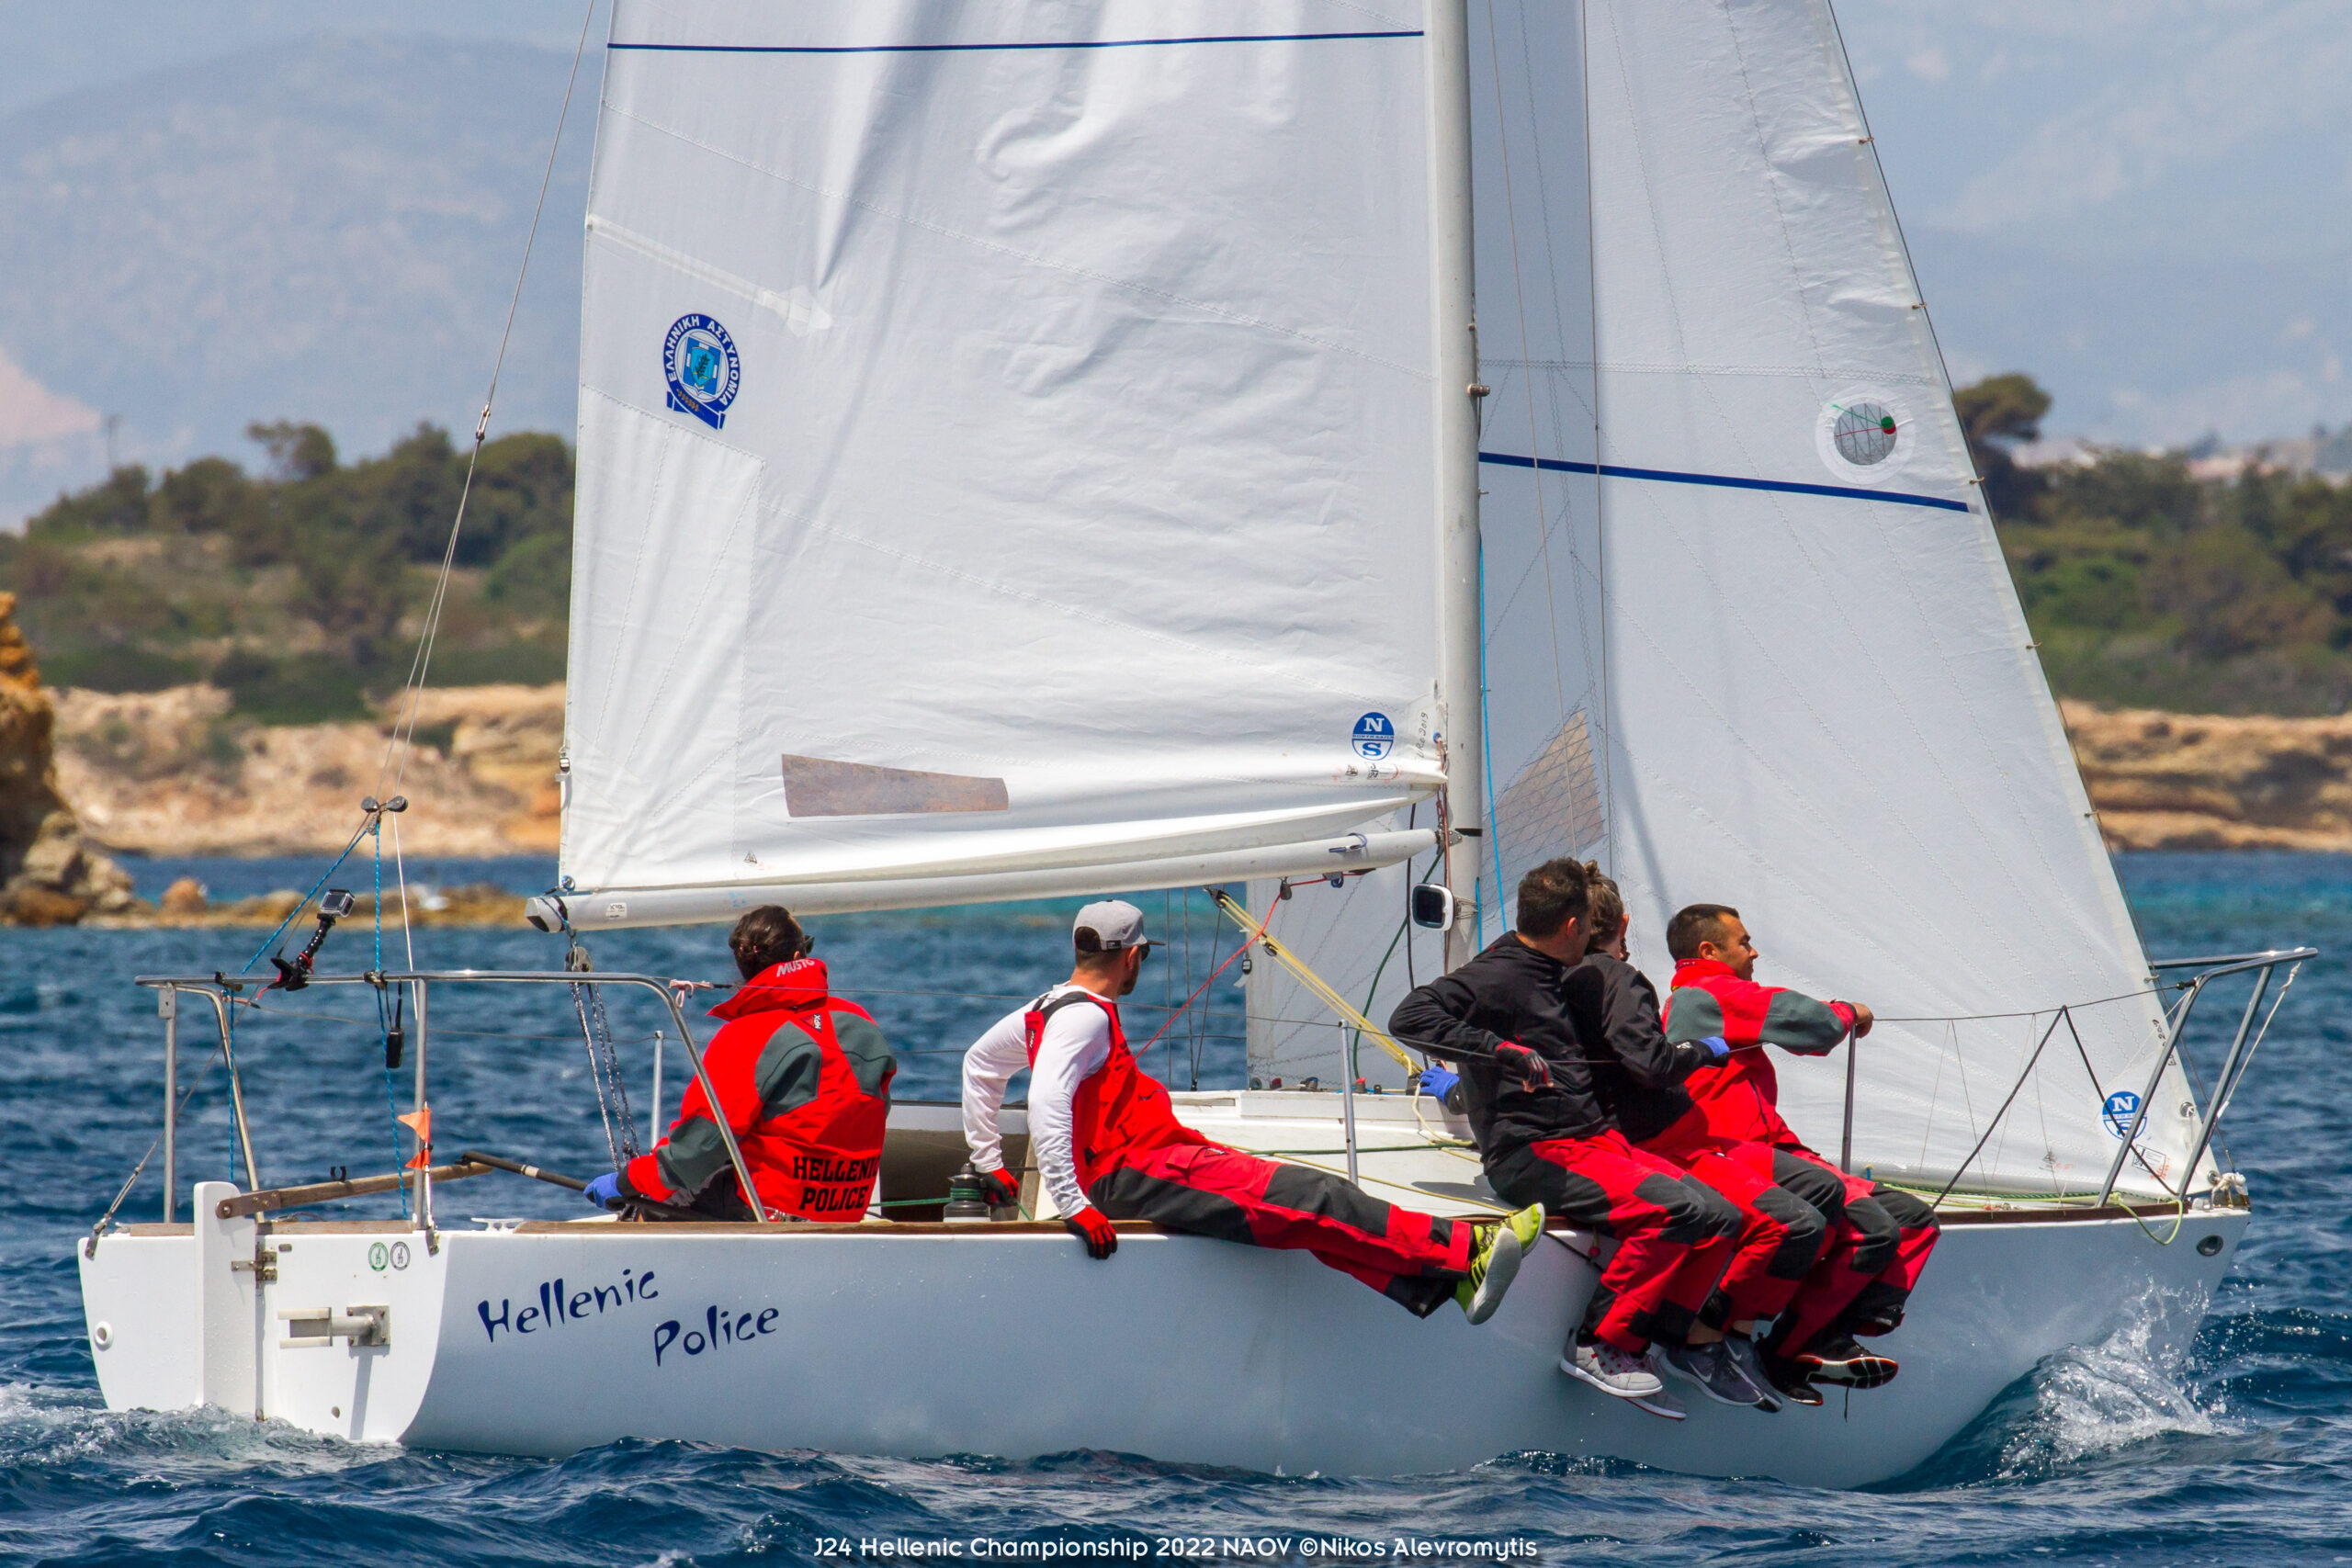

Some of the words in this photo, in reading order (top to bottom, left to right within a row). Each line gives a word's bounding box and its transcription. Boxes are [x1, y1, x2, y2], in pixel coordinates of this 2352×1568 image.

[664, 315, 700, 383] ΕΛΛΗΝΙΚΗ
[707, 320, 739, 406] ΑΣΤΥΝΟΜΙΑ
[1363, 717, 1385, 732] N
[1362, 741, 1382, 756] S
[776, 958, 816, 977] MUSTO
[2110, 1096, 2134, 1112] N
[798, 1185, 869, 1212] POLICE
[478, 1269, 660, 1343] Hellenic
[654, 1305, 779, 1367] Police
